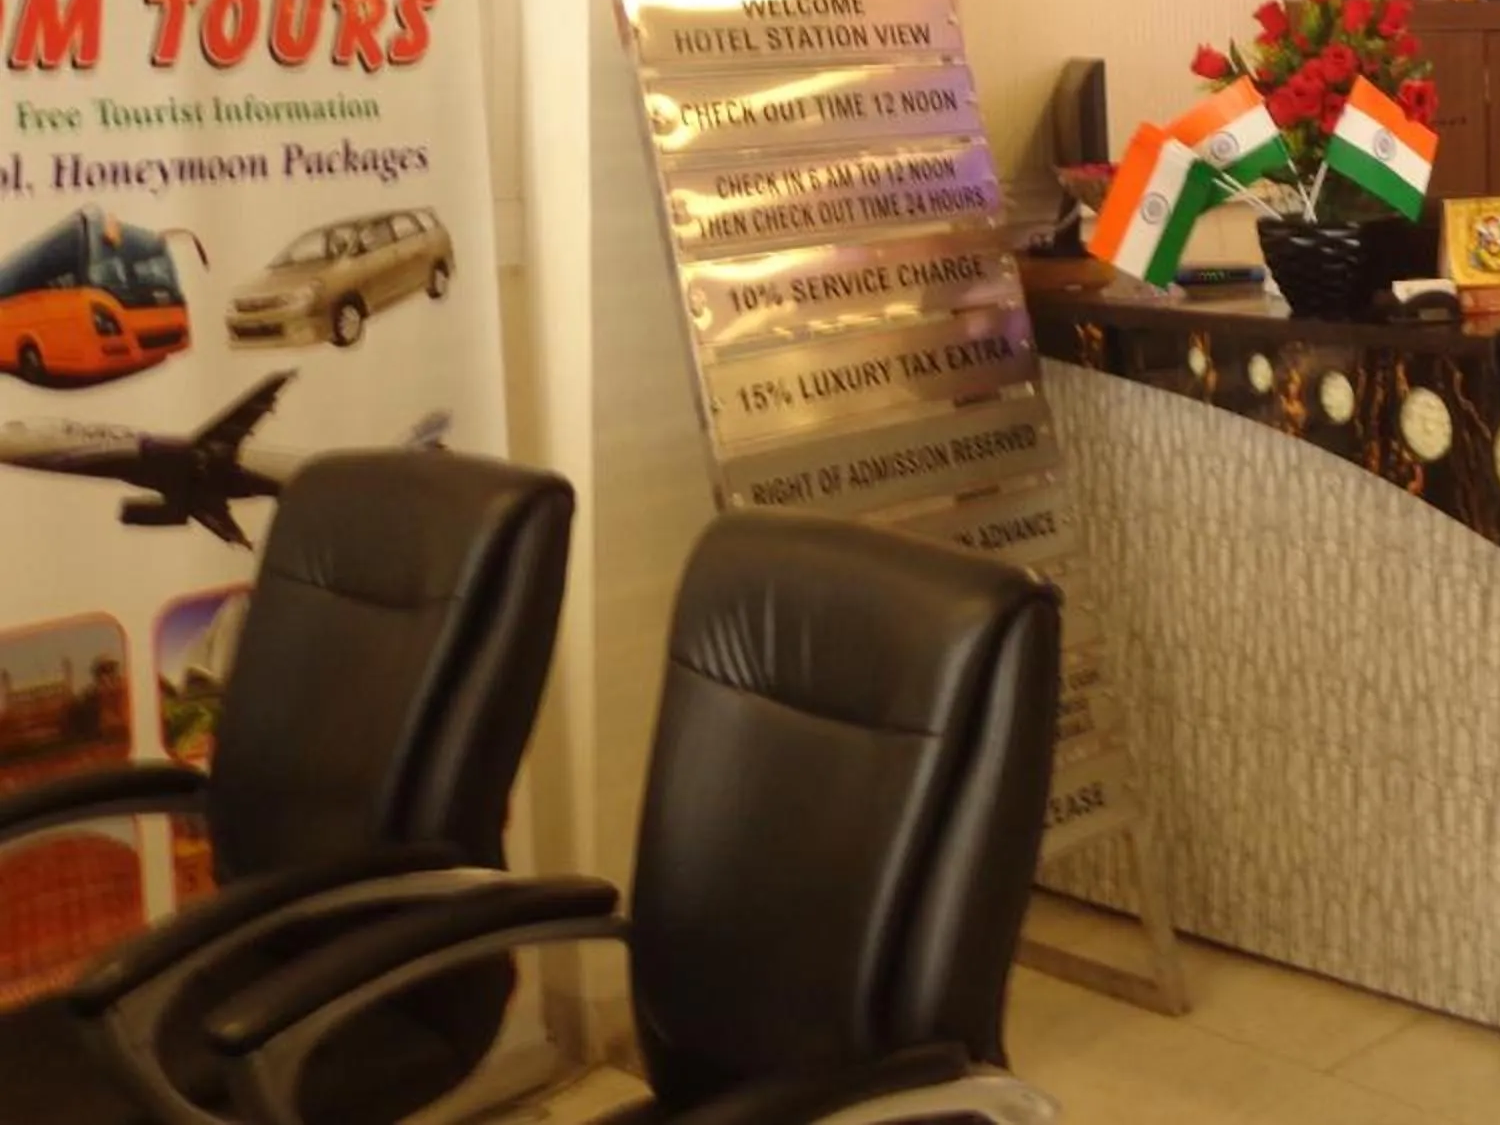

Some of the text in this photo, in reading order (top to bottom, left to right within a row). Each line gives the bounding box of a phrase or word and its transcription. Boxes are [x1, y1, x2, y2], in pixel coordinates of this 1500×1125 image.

[674, 23, 931, 55] HOTEL STATION VIEW
[16, 91, 381, 132] Free Tourist Information
[680, 88, 959, 128] CHECK OUT TIME 12 NOON
[50, 149, 269, 195] Honeymoon
[281, 138, 430, 183] Packages
[716, 171, 778, 200] CHECK
[783, 168, 805, 194] IN
[827, 165, 853, 190] AM
[856, 162, 881, 187] TO
[908, 157, 955, 182] NOON
[752, 205, 815, 236] CHECK
[820, 200, 855, 229] OUT
[861, 194, 900, 222] TIME
[930, 186, 987, 214] HOURS
[729, 254, 984, 313] 10% SERVICE CHARGE
[736, 336, 1014, 414] 15% LUXURY TAX EXTRA
[752, 423, 1037, 507] RIGHT OF ADMISSION RESERVED
[978, 509, 1058, 550] ADVANCE
